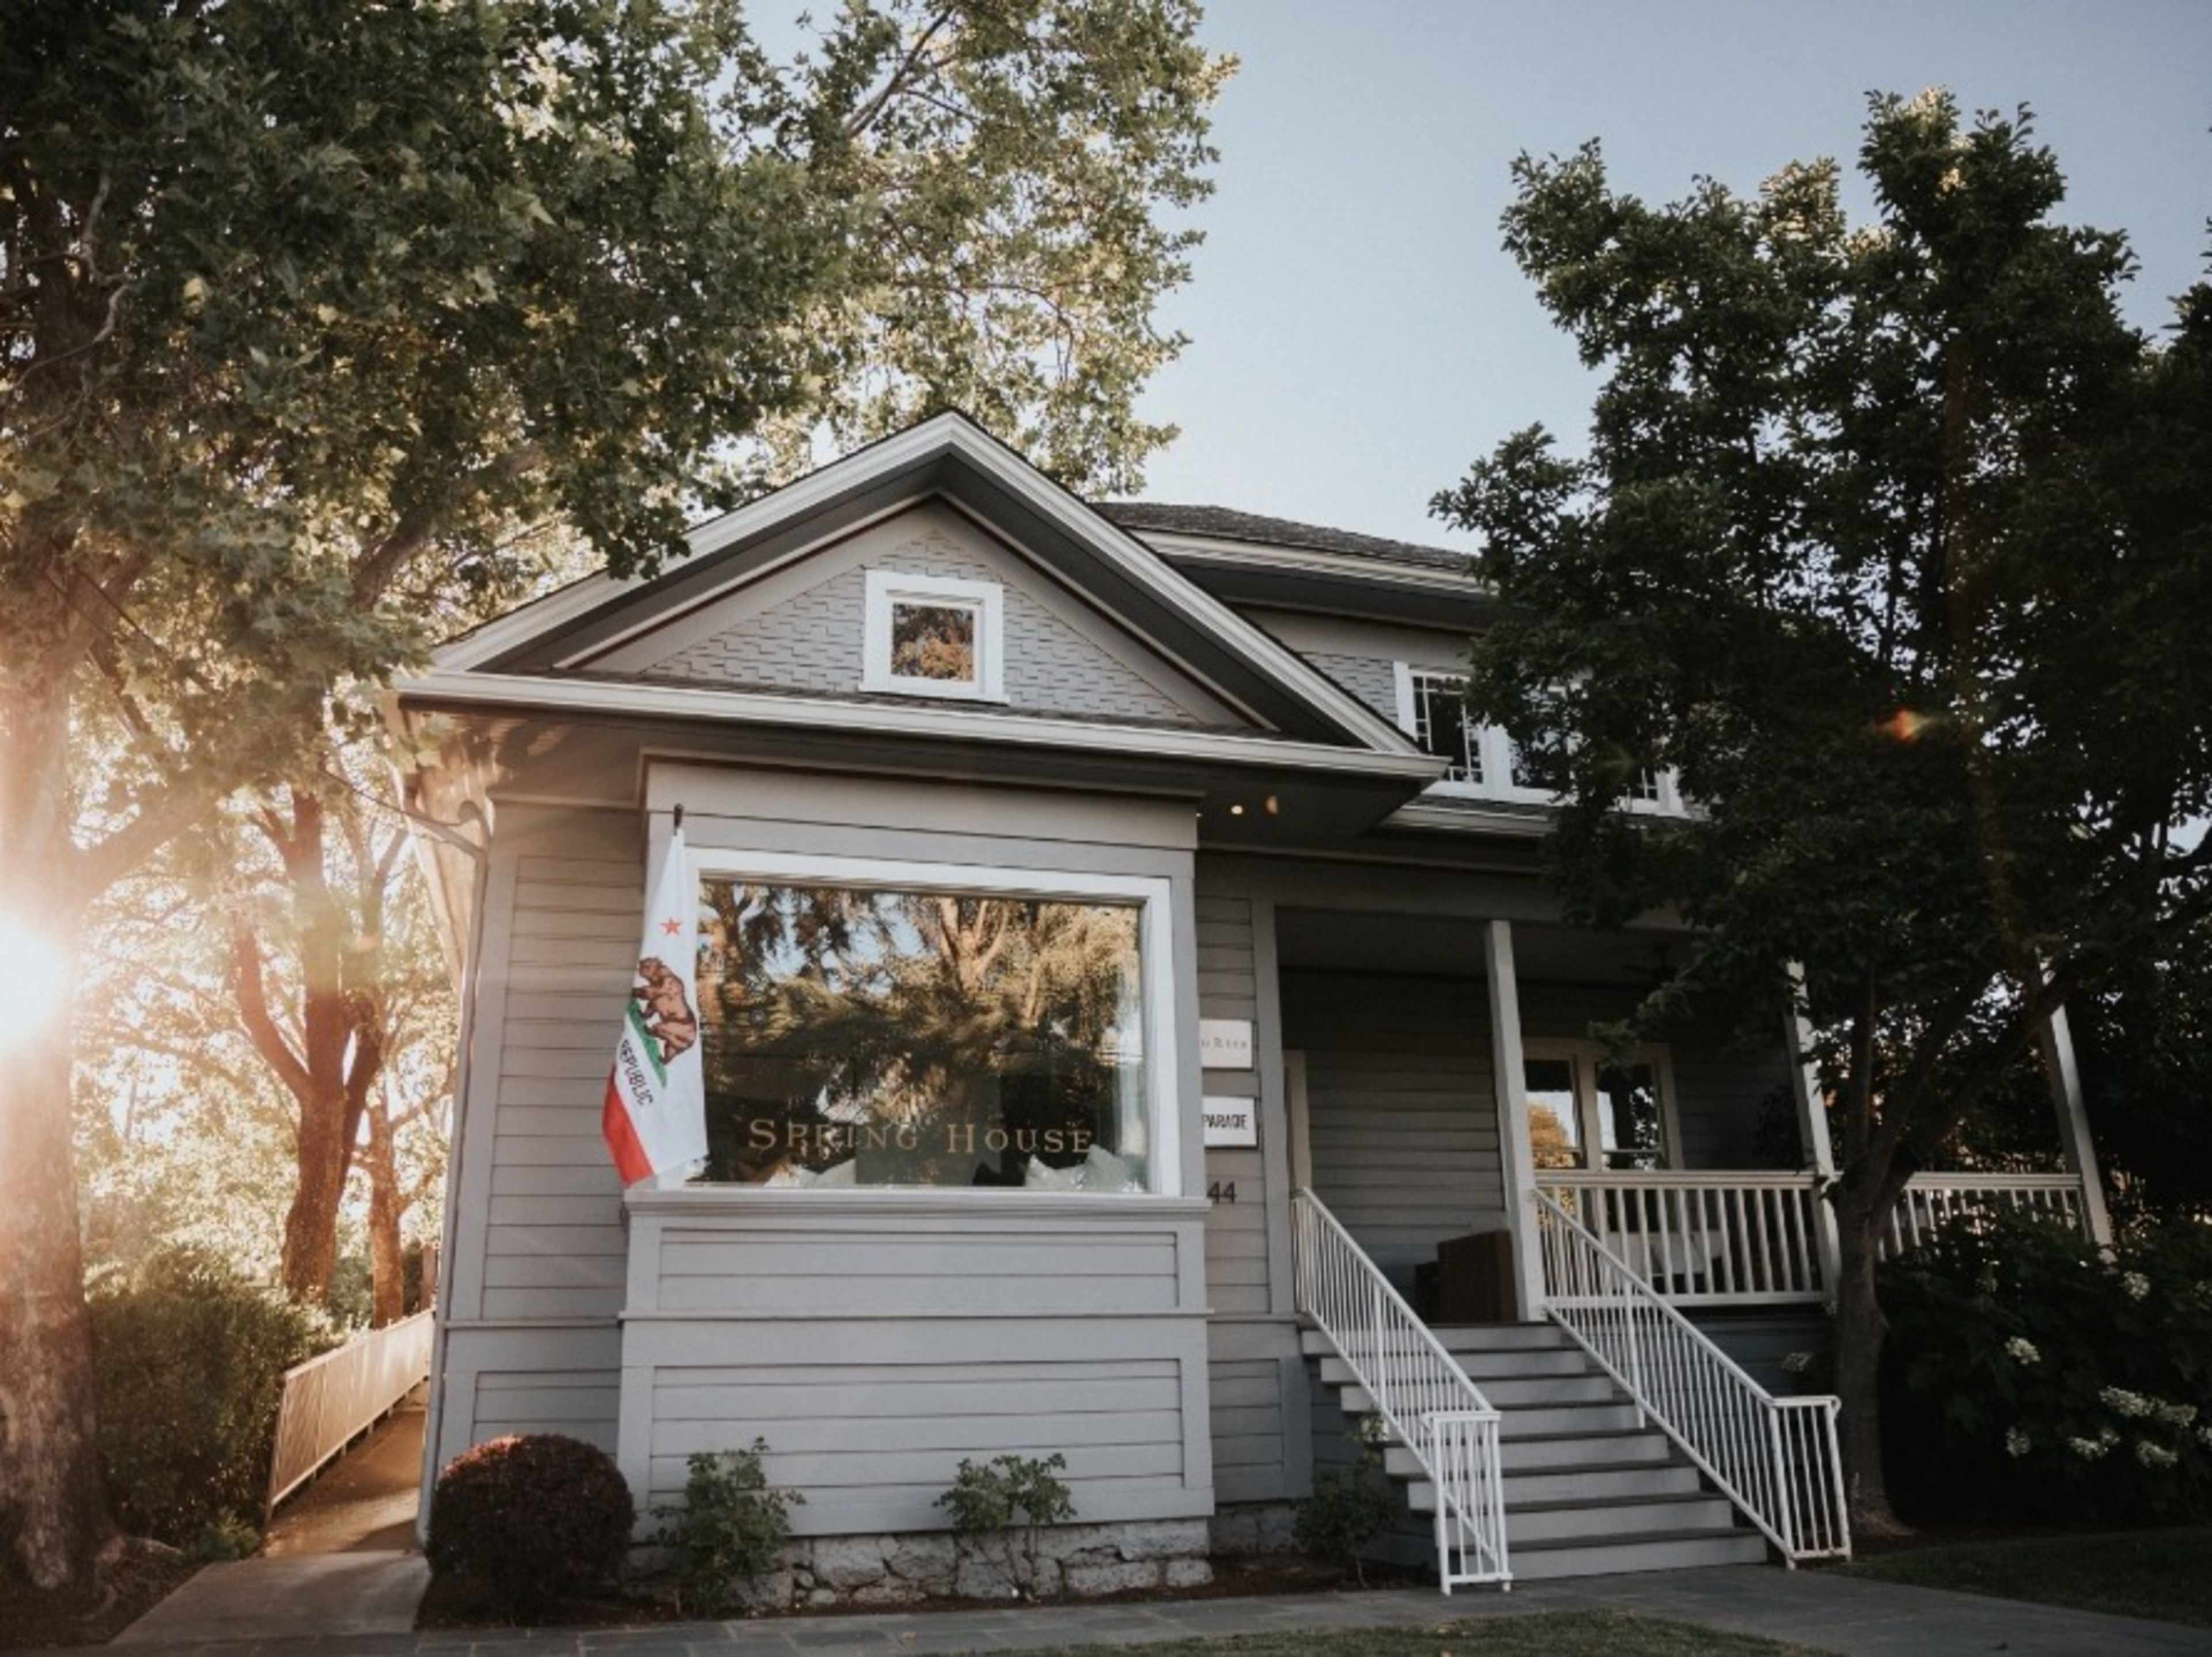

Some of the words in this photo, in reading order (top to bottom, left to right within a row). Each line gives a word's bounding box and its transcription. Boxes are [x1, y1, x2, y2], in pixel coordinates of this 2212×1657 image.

[749, 1118, 917, 1151] SPRING
[948, 1124, 1092, 1154] HOUSE
[1206, 1180, 1237, 1204] 44
